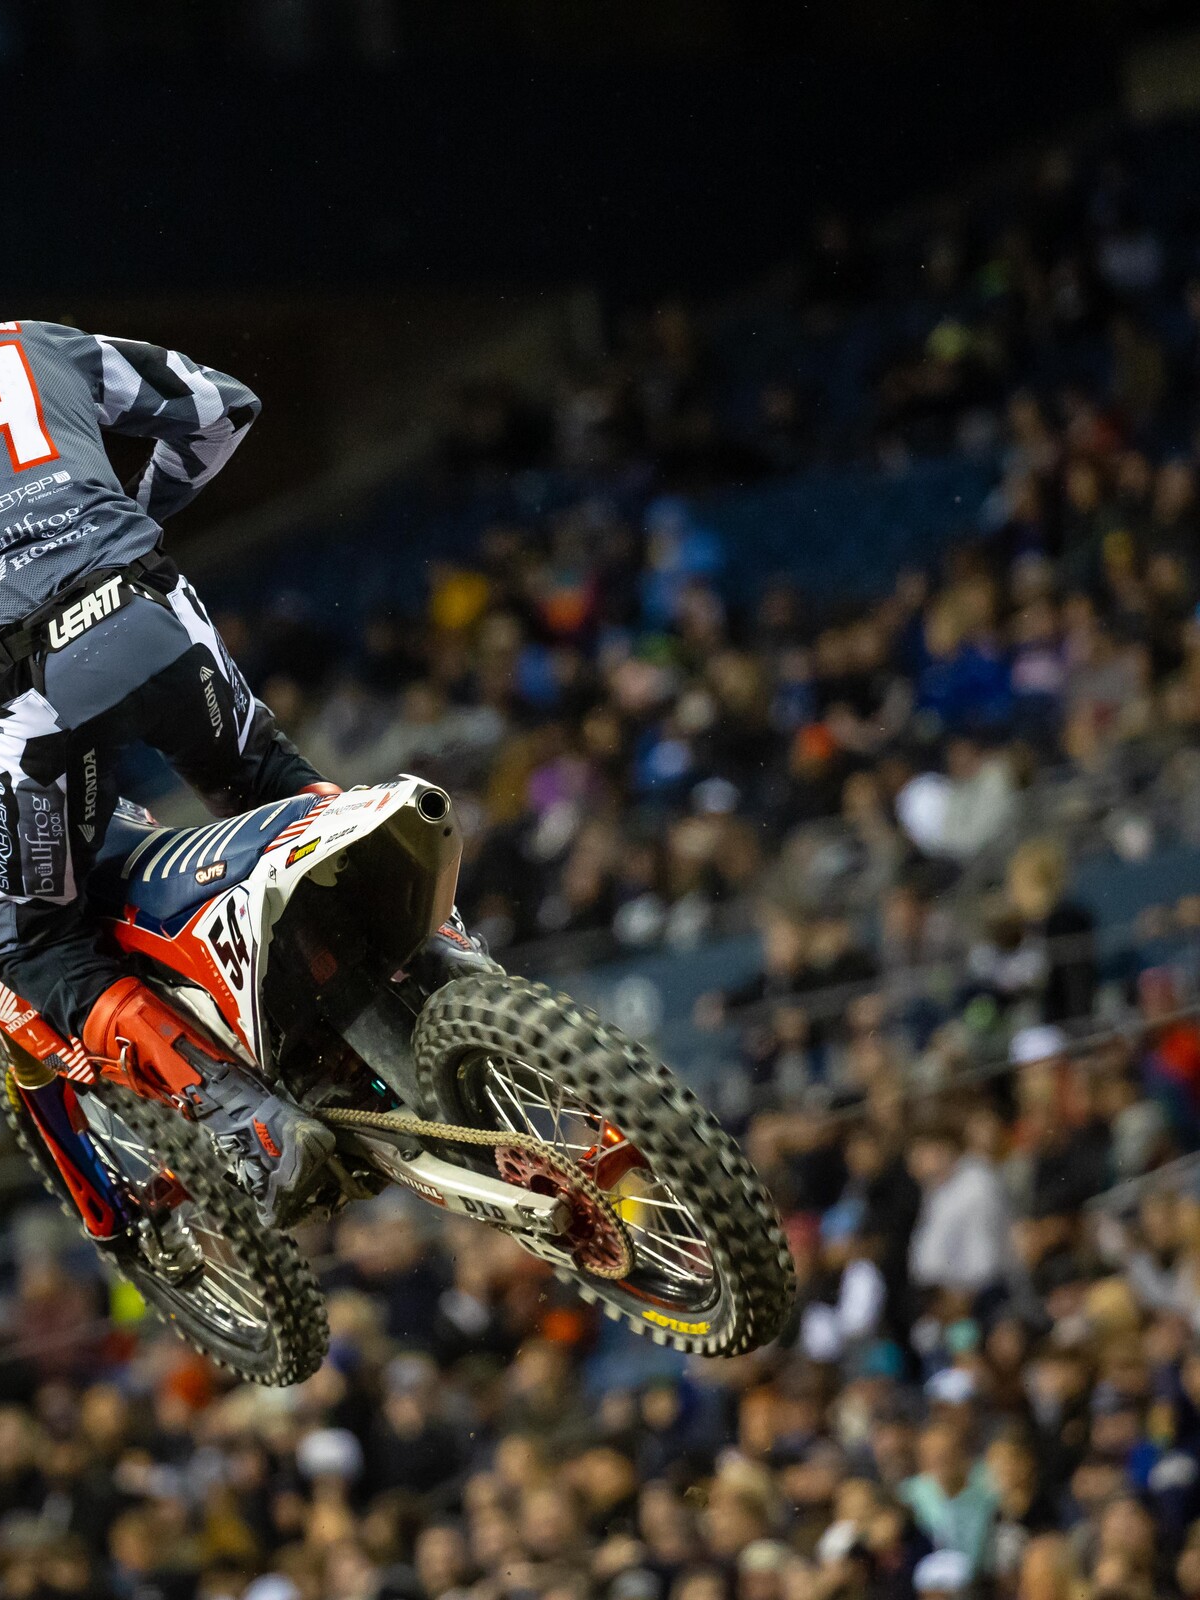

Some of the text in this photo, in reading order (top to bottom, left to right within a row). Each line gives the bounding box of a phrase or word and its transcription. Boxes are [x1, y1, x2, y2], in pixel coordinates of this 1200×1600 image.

[49, 575, 122, 649] LEATT
[83, 748, 96, 821] HONDA
[25, 793, 60, 894] bullfrog
[51, 812, 64, 838] spas
[195, 863, 225, 883] GUTS
[208, 896, 250, 990] 54
